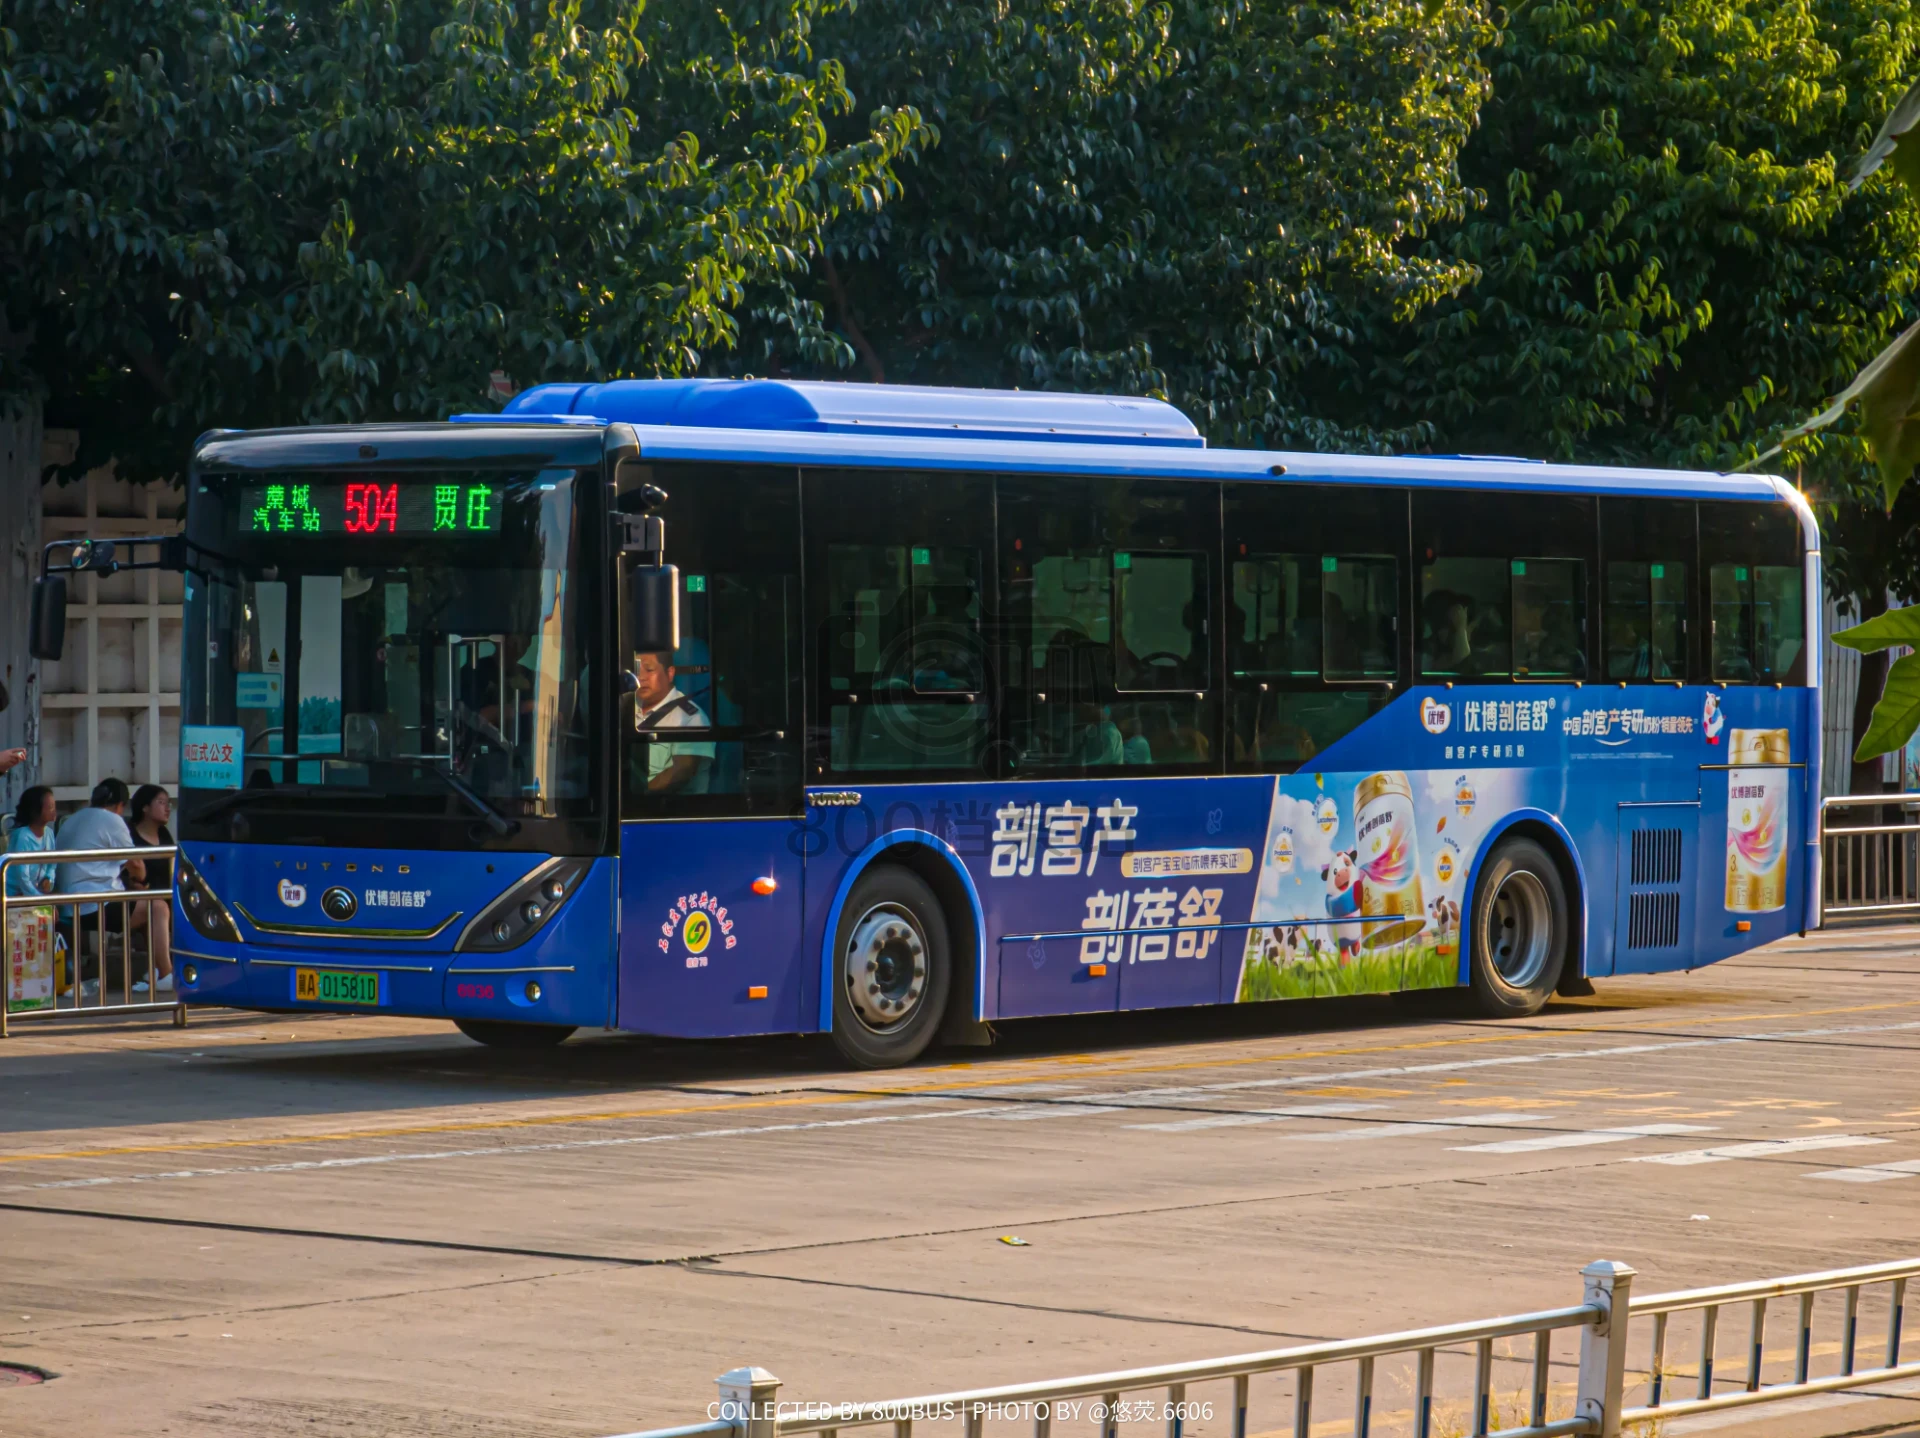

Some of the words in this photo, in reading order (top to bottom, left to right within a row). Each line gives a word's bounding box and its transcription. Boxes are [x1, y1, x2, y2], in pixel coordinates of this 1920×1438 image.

[253, 507, 320, 532] 汽车站
[345, 484, 398, 532] 504
[433, 484, 492, 531] 贾庄
[1428, 710, 1446, 725] 优博
[1445, 744, 1525, 759] 剖宫产专研奶粉
[808, 791, 862, 806] YUTONG
[990, 798, 1138, 877] 剖宫产
[274, 860, 411, 874] YUTONG
[1079, 886, 1224, 965] 剖蓓舒
